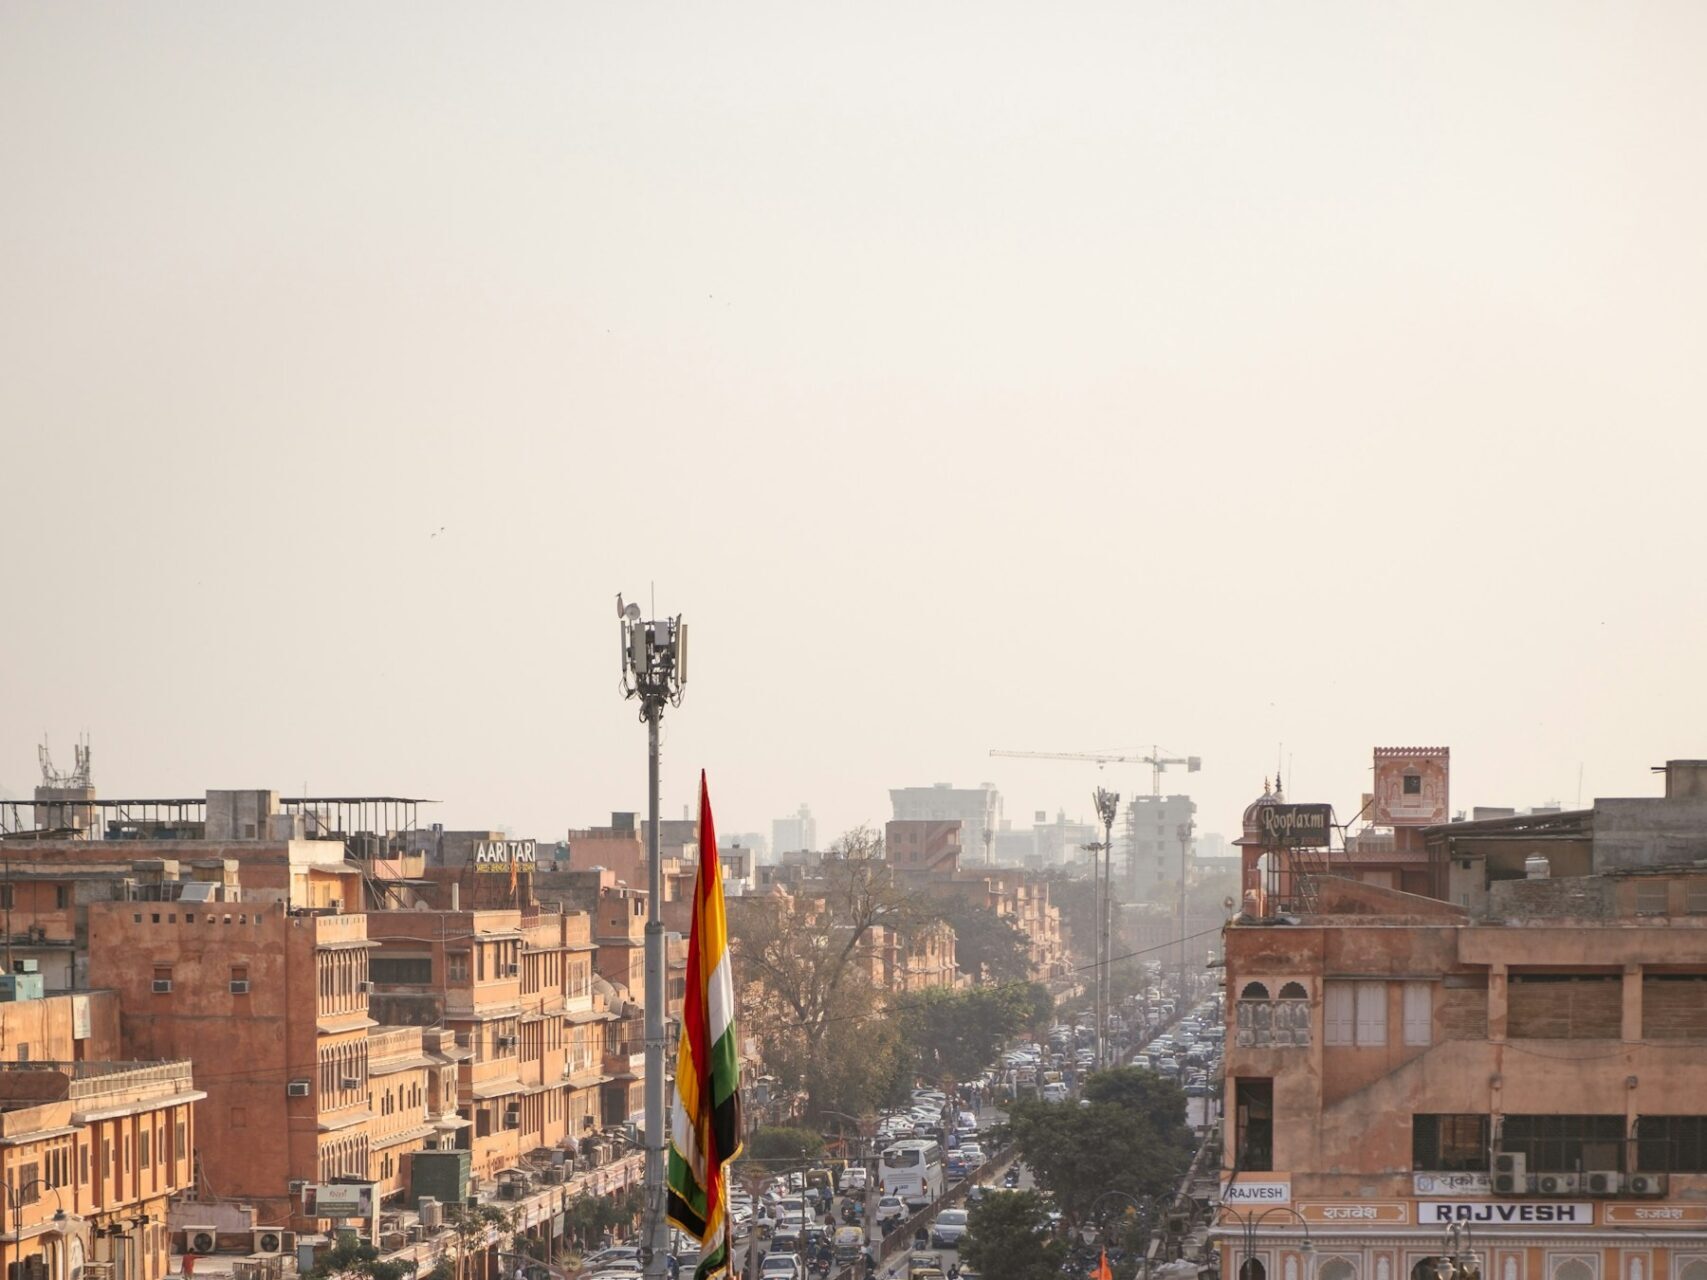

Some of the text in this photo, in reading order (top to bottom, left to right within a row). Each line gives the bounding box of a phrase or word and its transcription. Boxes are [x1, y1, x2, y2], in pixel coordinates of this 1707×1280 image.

[1262, 807, 1324, 837] Rooplaxmi
[476, 841, 536, 862] AARI TARI
[1229, 1188, 1283, 1199] RAJVESH
[1436, 1204, 1575, 1222] RAJVESH
